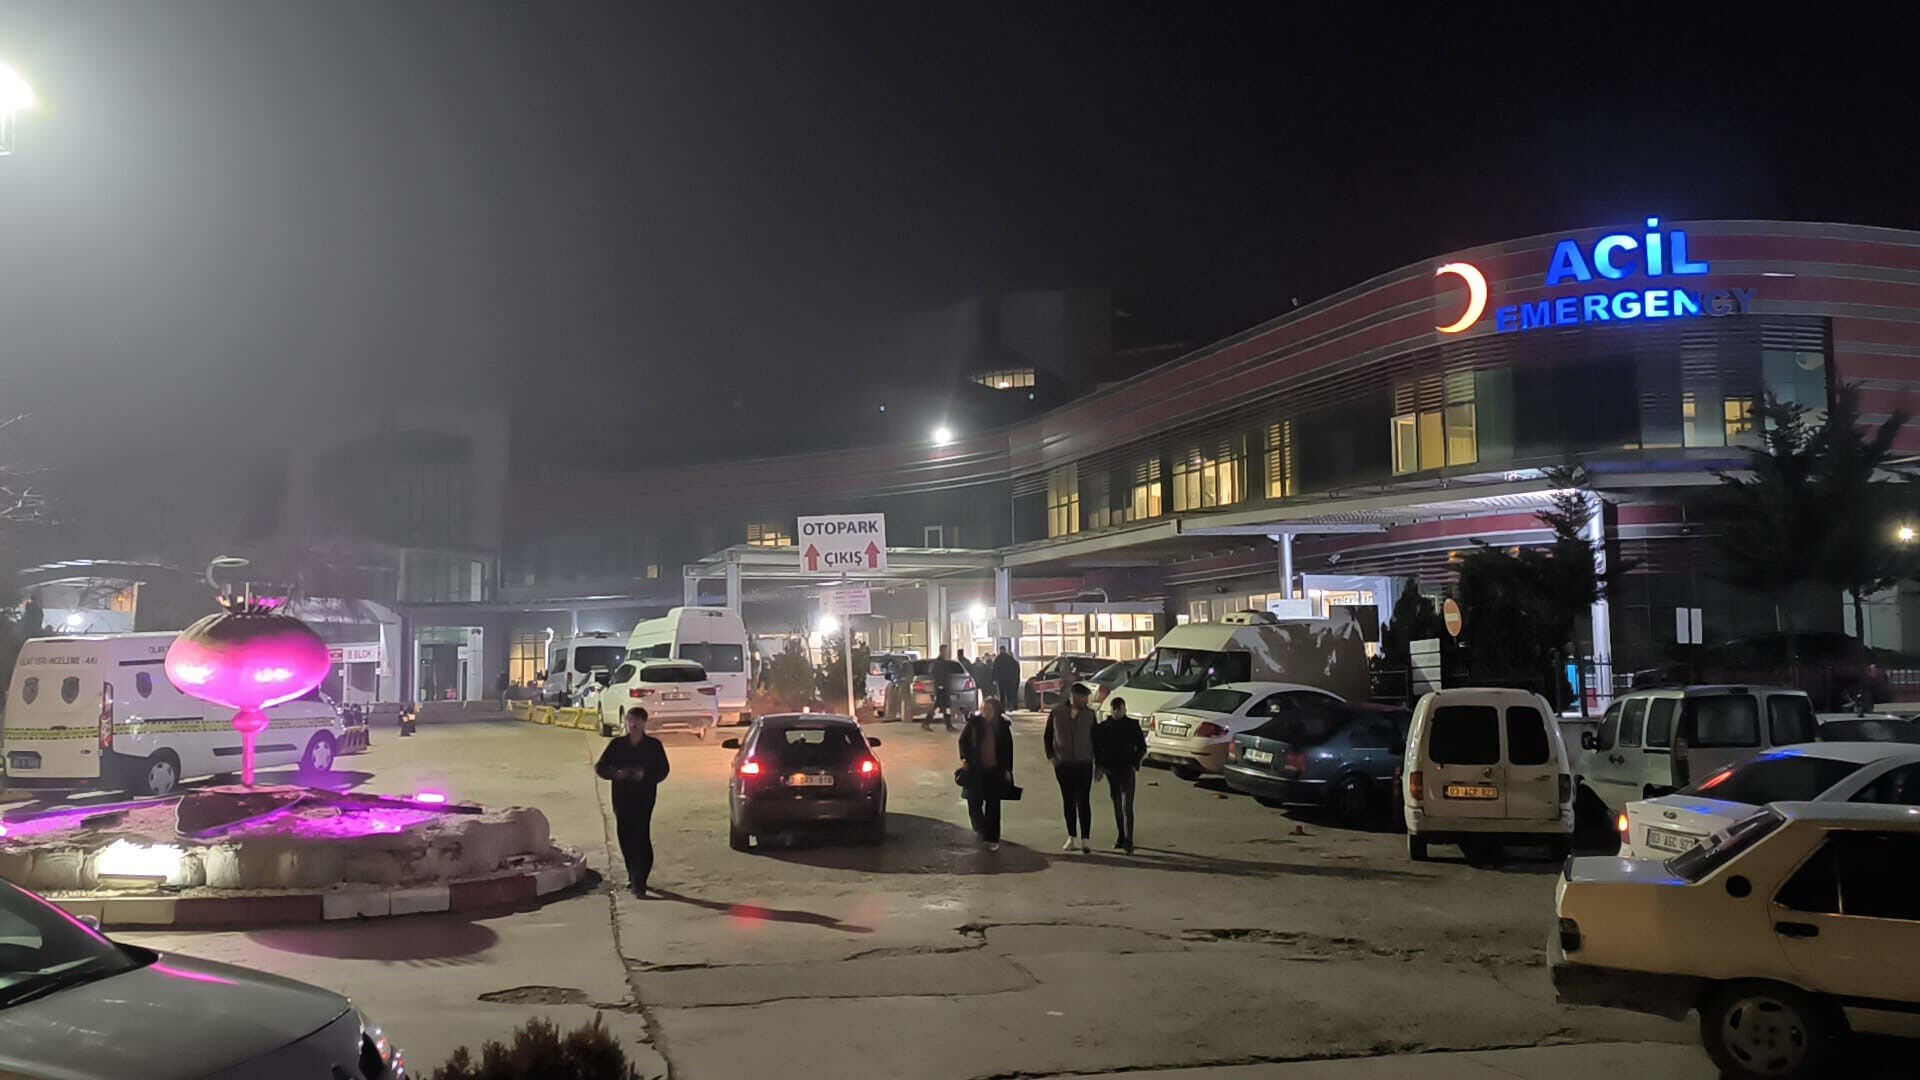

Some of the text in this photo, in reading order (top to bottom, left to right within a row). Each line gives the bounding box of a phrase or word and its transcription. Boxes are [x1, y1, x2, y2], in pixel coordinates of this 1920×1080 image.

[1545, 217, 1709, 286] ACİL
[1495, 288, 1758, 332] EMERGENCY
[803, 520, 879, 536] OTOPARK
[824, 551, 863, 568] ÇIKIŞ
